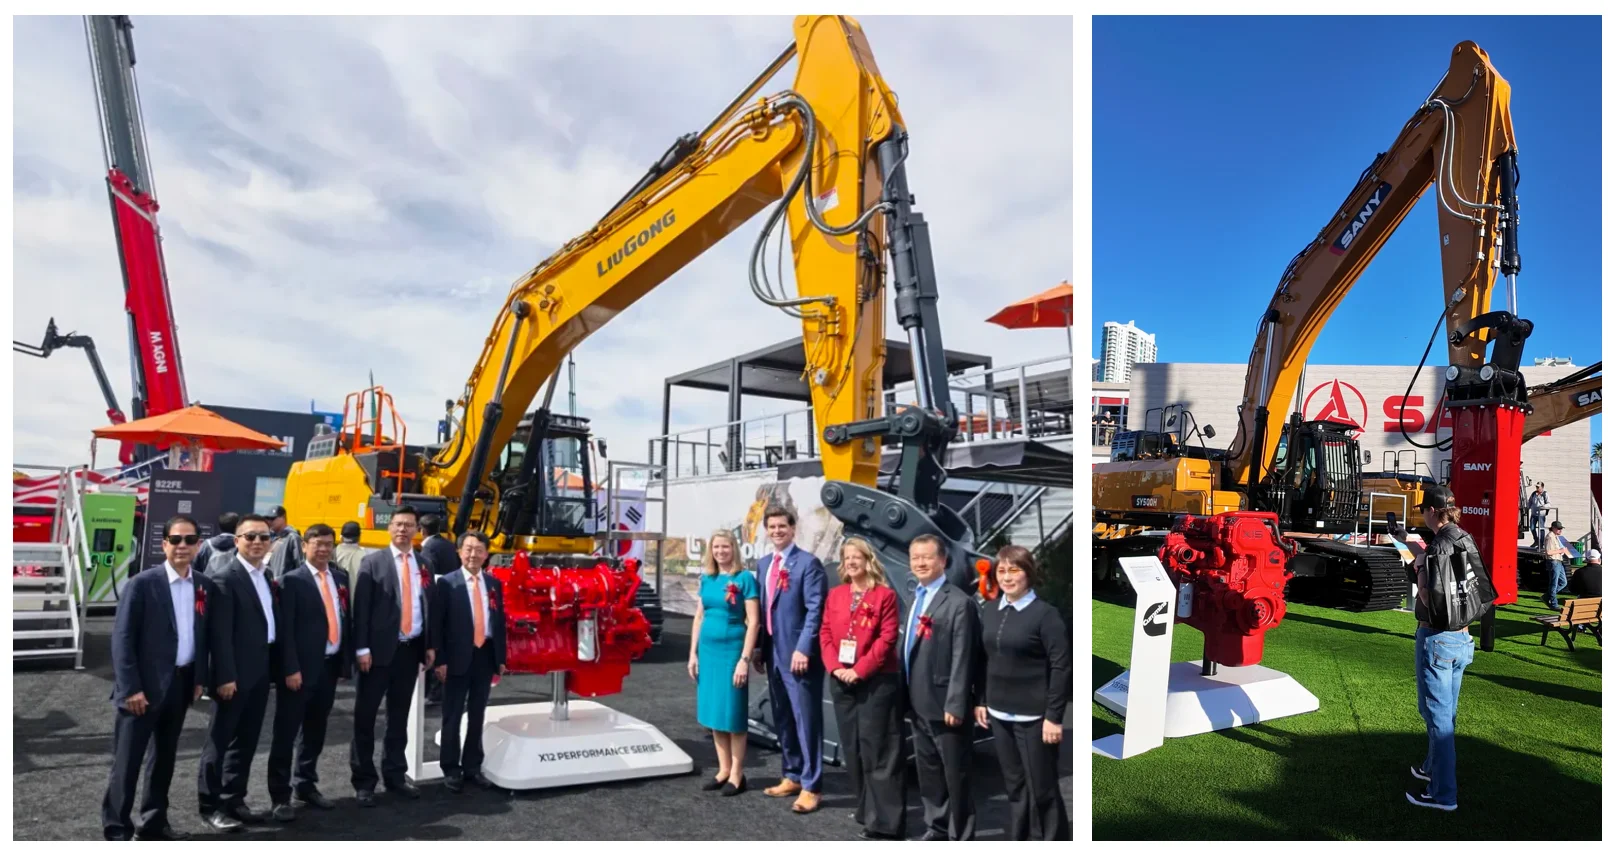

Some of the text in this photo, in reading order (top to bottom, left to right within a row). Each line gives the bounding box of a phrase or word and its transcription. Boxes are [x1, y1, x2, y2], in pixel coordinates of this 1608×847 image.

[1341, 188, 1381, 249] SANY
[150, 331, 168, 373] MAGNI
[1578, 389, 1602, 407] SA
[1463, 463, 1492, 471] SANY
[1136, 497, 1158, 506] SY500H
[1462, 506, 1490, 516] B500H
[538, 743, 663, 762] X12 PERFORMANCE SERIES
